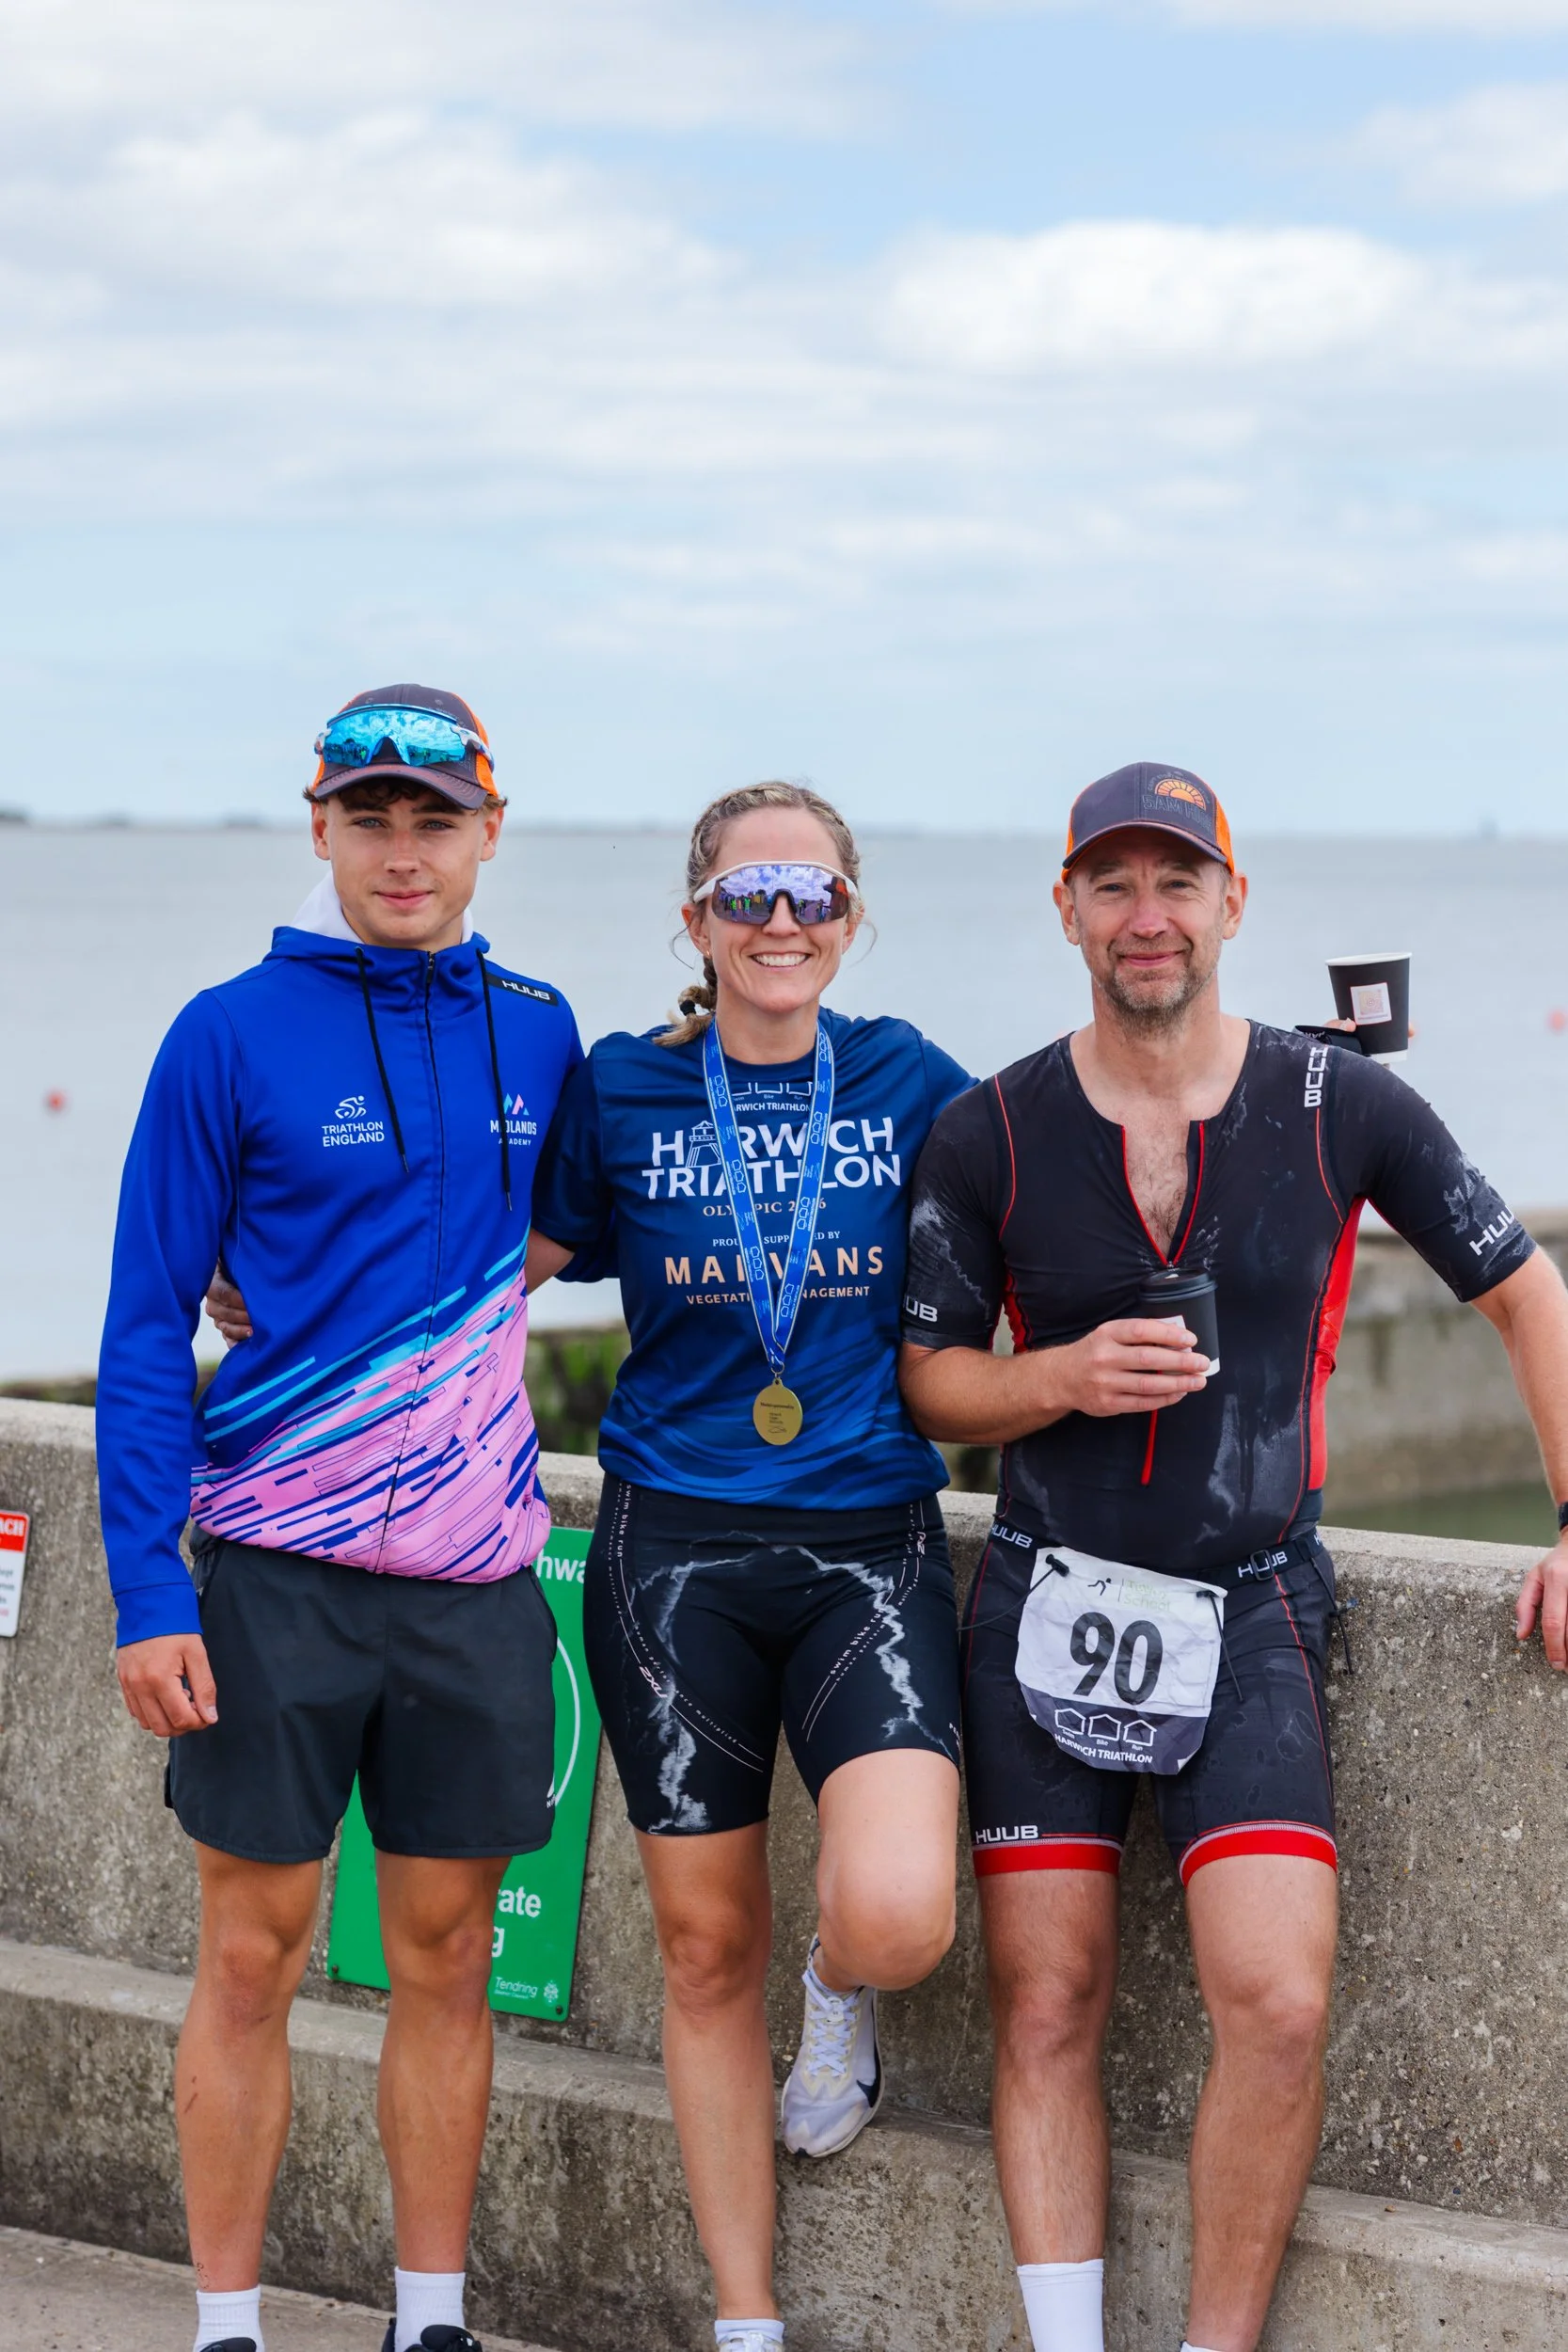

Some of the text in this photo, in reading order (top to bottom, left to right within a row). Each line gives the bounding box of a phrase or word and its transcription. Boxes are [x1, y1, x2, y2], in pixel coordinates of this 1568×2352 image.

[501, 980, 551, 1001] HUUB
[1304, 1046, 1329, 1108] HUUB
[734, 1102, 766, 1112] RWICH
[322, 1121, 384, 1136] TRIATHLON
[490, 1120, 537, 1136] MDLANDS
[323, 1132, 385, 1148] ENGLAND
[499, 1137, 531, 1146] AADEMY
[703, 1197, 827, 1217] OLYPIC 26
[828, 1231, 841, 1240] BY
[1468, 1204, 1515, 1256] HUU
[687, 1286, 870, 1305] VEGETATI NAGEMENT
[905, 1295, 938, 1323] UB
[624, 1484, 632, 1511] swim
[619, 1514, 628, 1535] bike
[830, 1608, 885, 1675] swim bike run
[1069, 1611, 1164, 1706] 90
[1053, 1733, 1153, 1764] HARWICH TRIATHLON
[1096, 1739, 1109, 1747] Bike
[1131, 1743, 1144, 1752] Run
[974, 1824, 1039, 1845] HUUB
[498, 1885, 543, 1918] ate
[495, 1976, 539, 1998] Tendring
